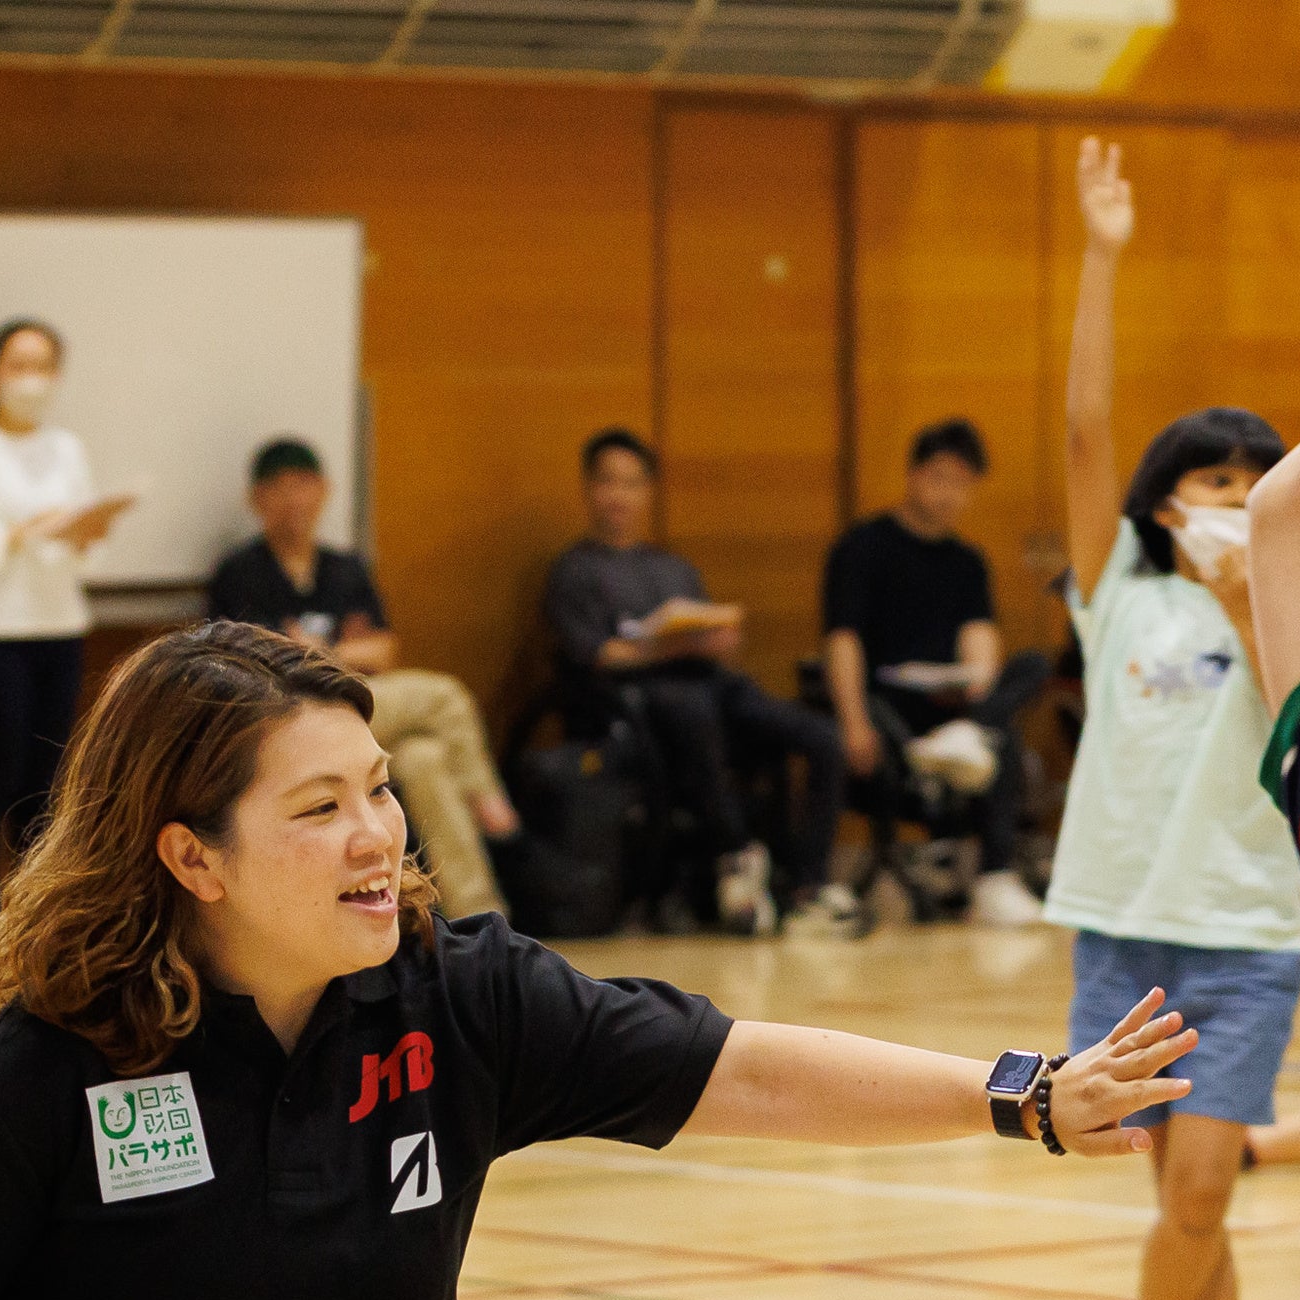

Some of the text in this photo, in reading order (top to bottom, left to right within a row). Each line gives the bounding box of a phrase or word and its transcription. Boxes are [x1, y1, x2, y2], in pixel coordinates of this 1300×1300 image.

[349, 1031, 434, 1123] JTB
[137, 1085, 185, 1110] 日本
[108, 1132, 198, 1170] パラサポ
[125, 1168, 153, 1178] NIPPON
[154, 1160, 200, 1173] FOUNDATION
